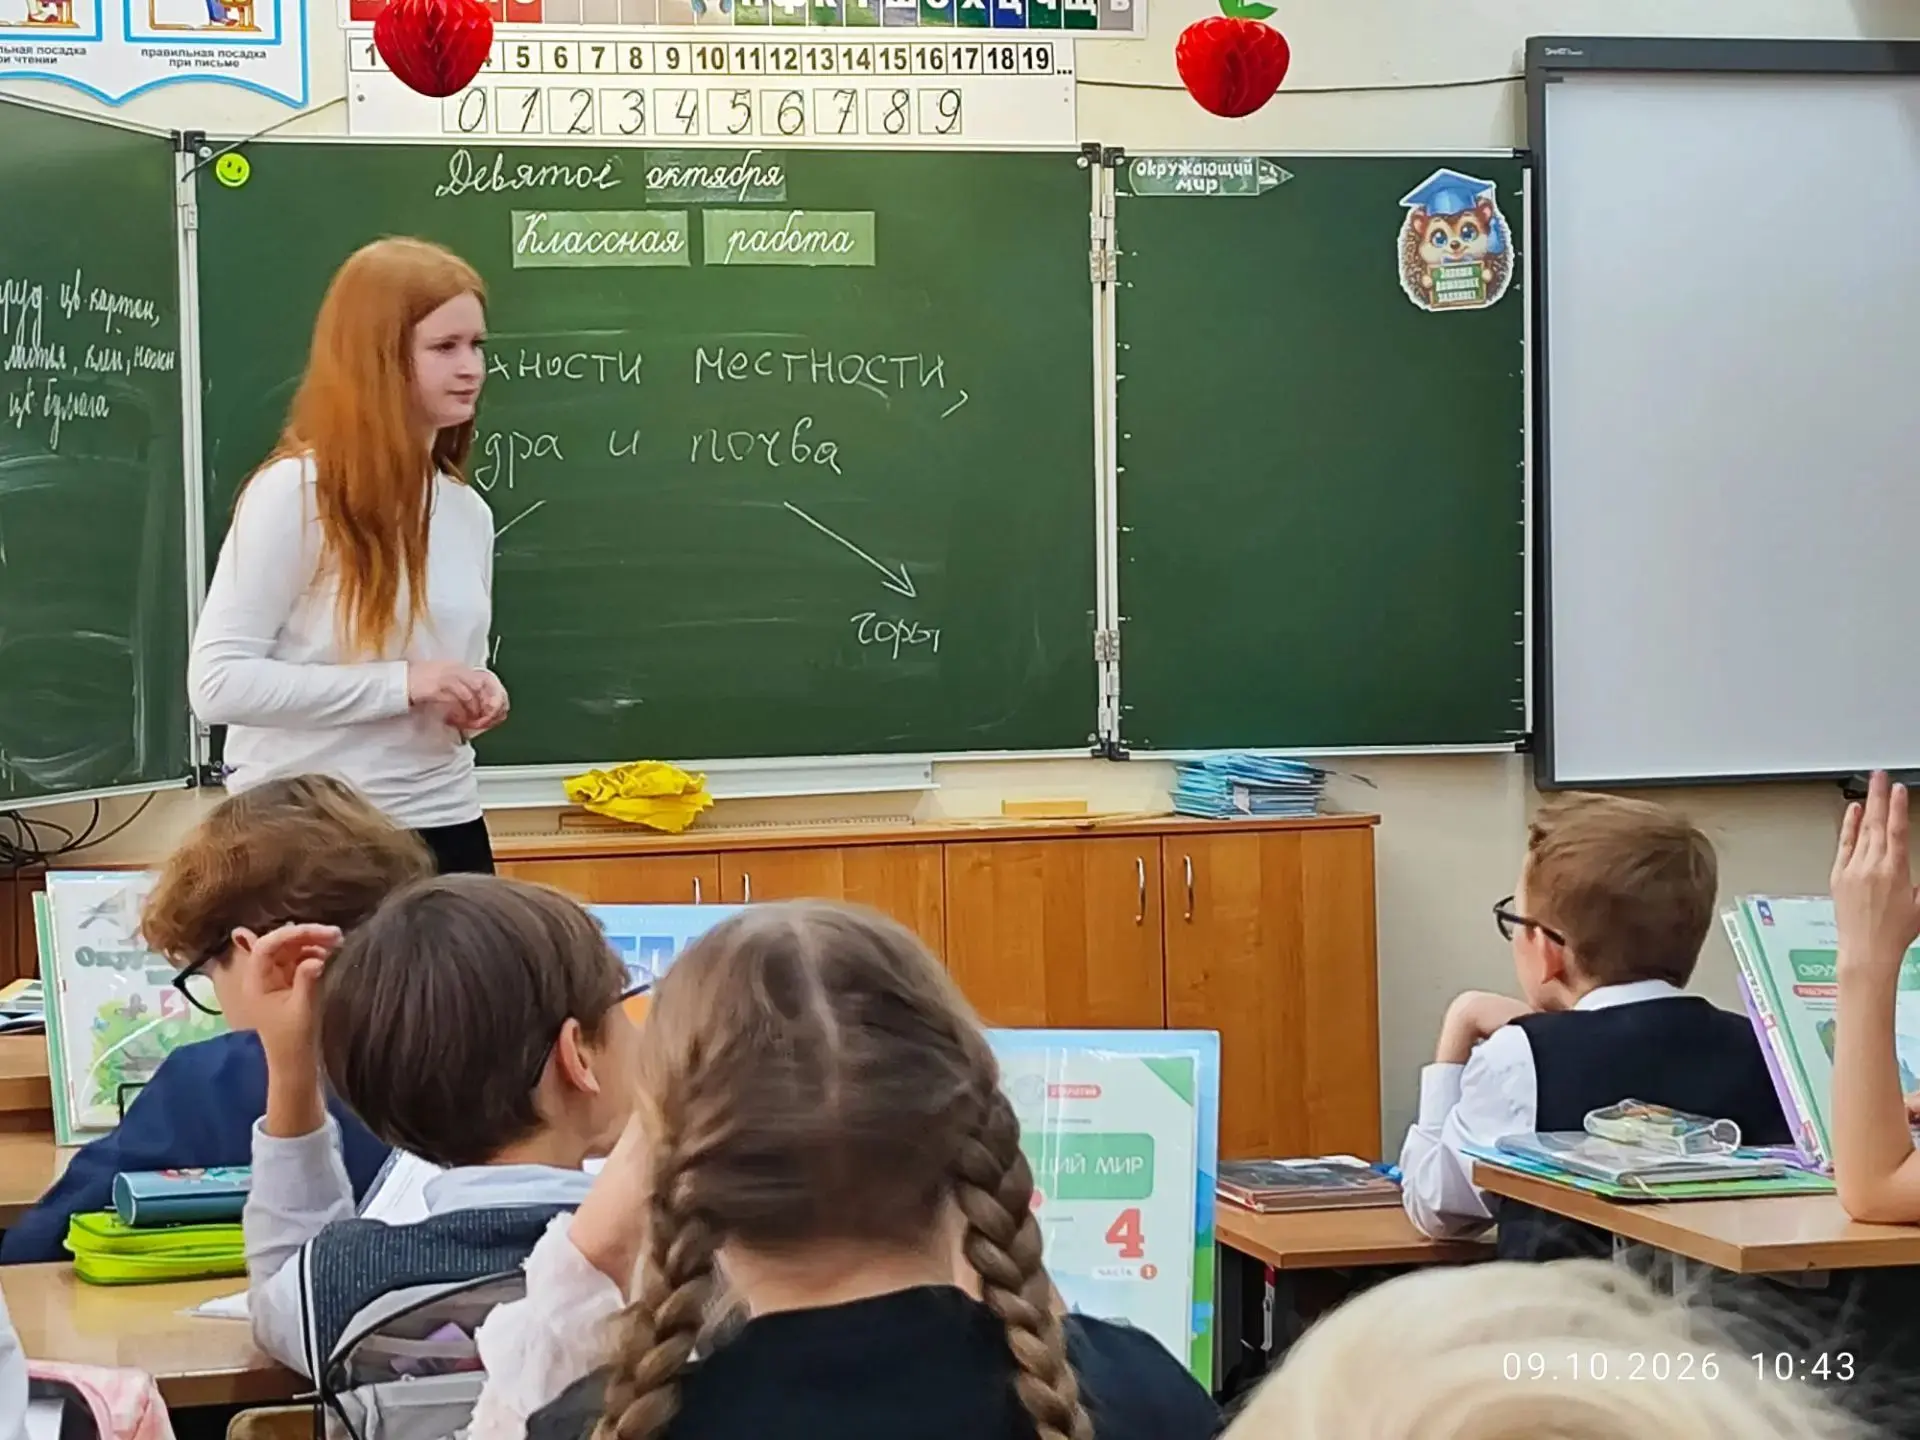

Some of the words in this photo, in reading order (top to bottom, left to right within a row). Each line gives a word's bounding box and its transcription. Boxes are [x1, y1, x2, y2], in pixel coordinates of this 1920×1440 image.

[15, 56, 58, 64] чтении
[37, 46, 87, 56] посадка
[141, 48, 215, 59] правильная
[218, 49, 267, 59] посадка
[169, 58, 192, 69] при
[195, 59, 240, 68] письме
[516, 46, 530, 68] 5
[554, 46, 568, 68] 6
[591, 46, 606, 68] 7
[629, 47, 643, 69] 8
[666, 47, 680, 69] 9
[697, 47, 724, 70] 10
[735, 47, 761, 70] 11
[771, 47, 798, 70] 12
[806, 47, 834, 70] 13
[843, 47, 871, 70] 14
[880, 47, 908, 70] 15
[916, 47, 944, 70] 16
[952, 47, 979, 70] 17
[988, 47, 1015, 70] 18
[1023, 47, 1050, 70] 19
[459, 88, 486, 132] 0
[521, 88, 541, 132] 1
[568, 89, 592, 134] 2
[619, 90, 644, 134] 3
[676, 90, 697, 134] 4
[727, 89, 751, 134] 5
[778, 89, 804, 135] 6
[833, 89, 857, 134] 7
[884, 89, 909, 134] 8
[936, 89, 962, 134] 9
[435, 149, 621, 197] Девятое
[646, 150, 785, 202] октября
[1175, 177, 1219, 194] мир
[516, 212, 685, 254] Классная
[723, 210, 856, 264] работа
[489, 349, 642, 384] хности
[475, 431, 564, 491] дра
[609, 430, 640, 457] и
[691, 417, 842, 475] почва
[850, 612, 941, 660] горы
[1096, 1155, 1144, 1175] МИР
[1105, 1208, 1145, 1258] 4
